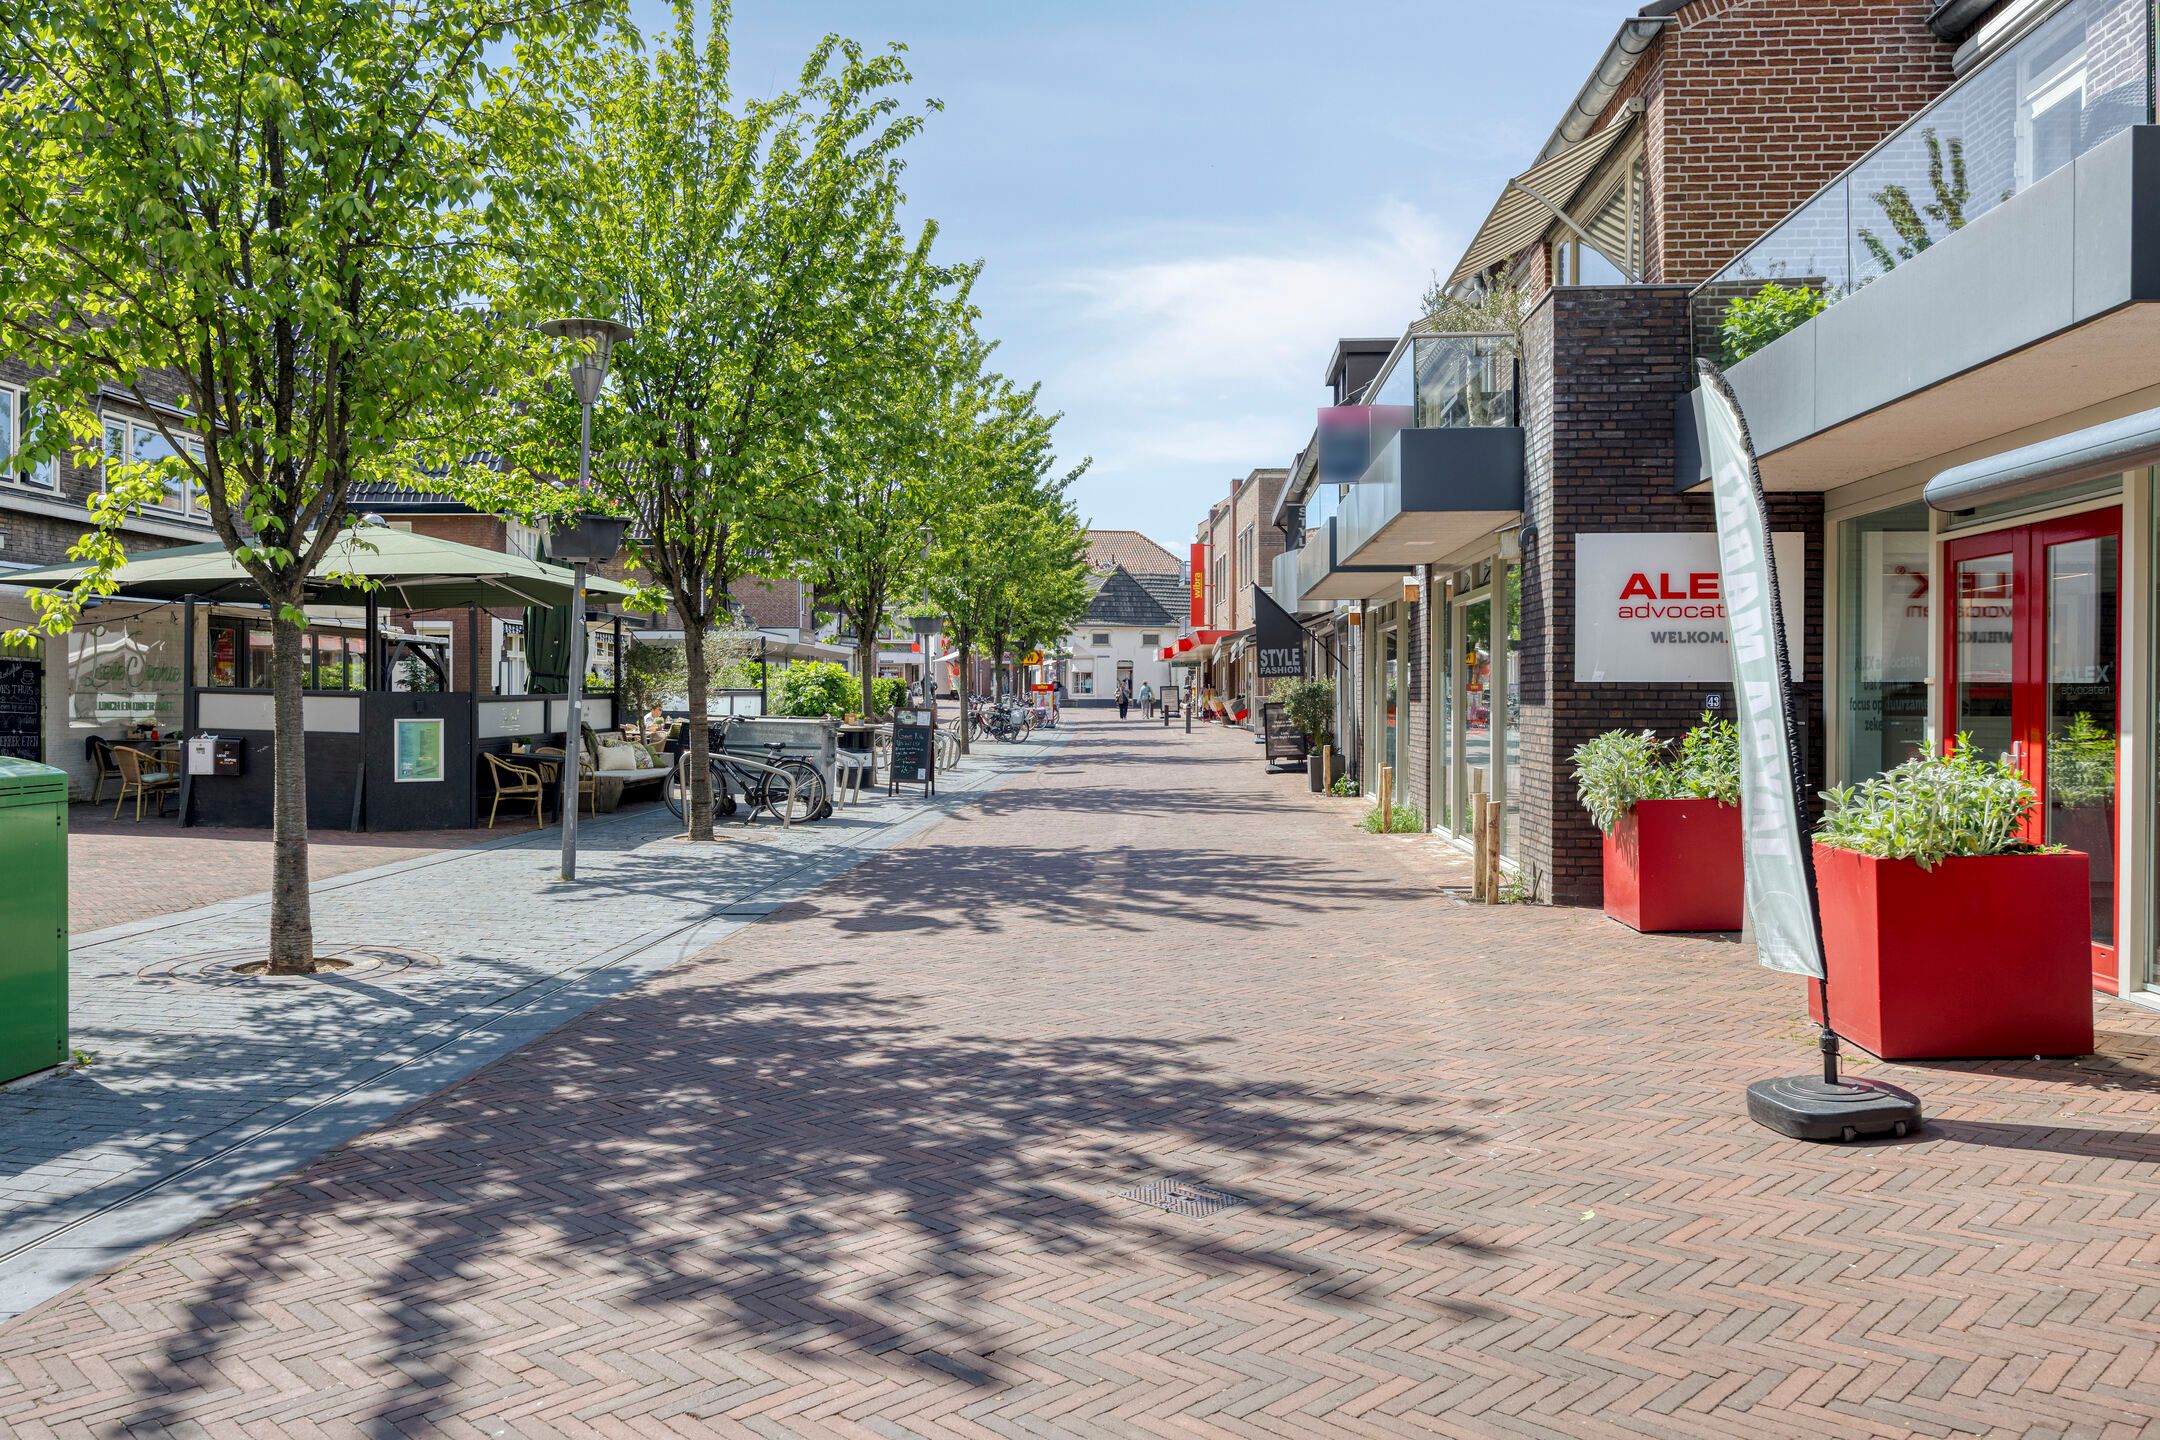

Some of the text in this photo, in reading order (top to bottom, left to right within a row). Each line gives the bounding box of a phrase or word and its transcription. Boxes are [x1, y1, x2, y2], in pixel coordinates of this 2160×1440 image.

[1298, 506, 1306, 547] STYL
[1193, 572, 1201, 599] wibra
[1619, 573, 1720, 600] ALE
[1618, 602, 1726, 618] advocat
[1651, 631, 1729, 644] WELKOM.
[1260, 648, 1301, 667] STYLE
[1260, 666, 1301, 674] FASHION
[2061, 684, 2110, 695] advocaten
[1708, 693, 1719, 706] 43
